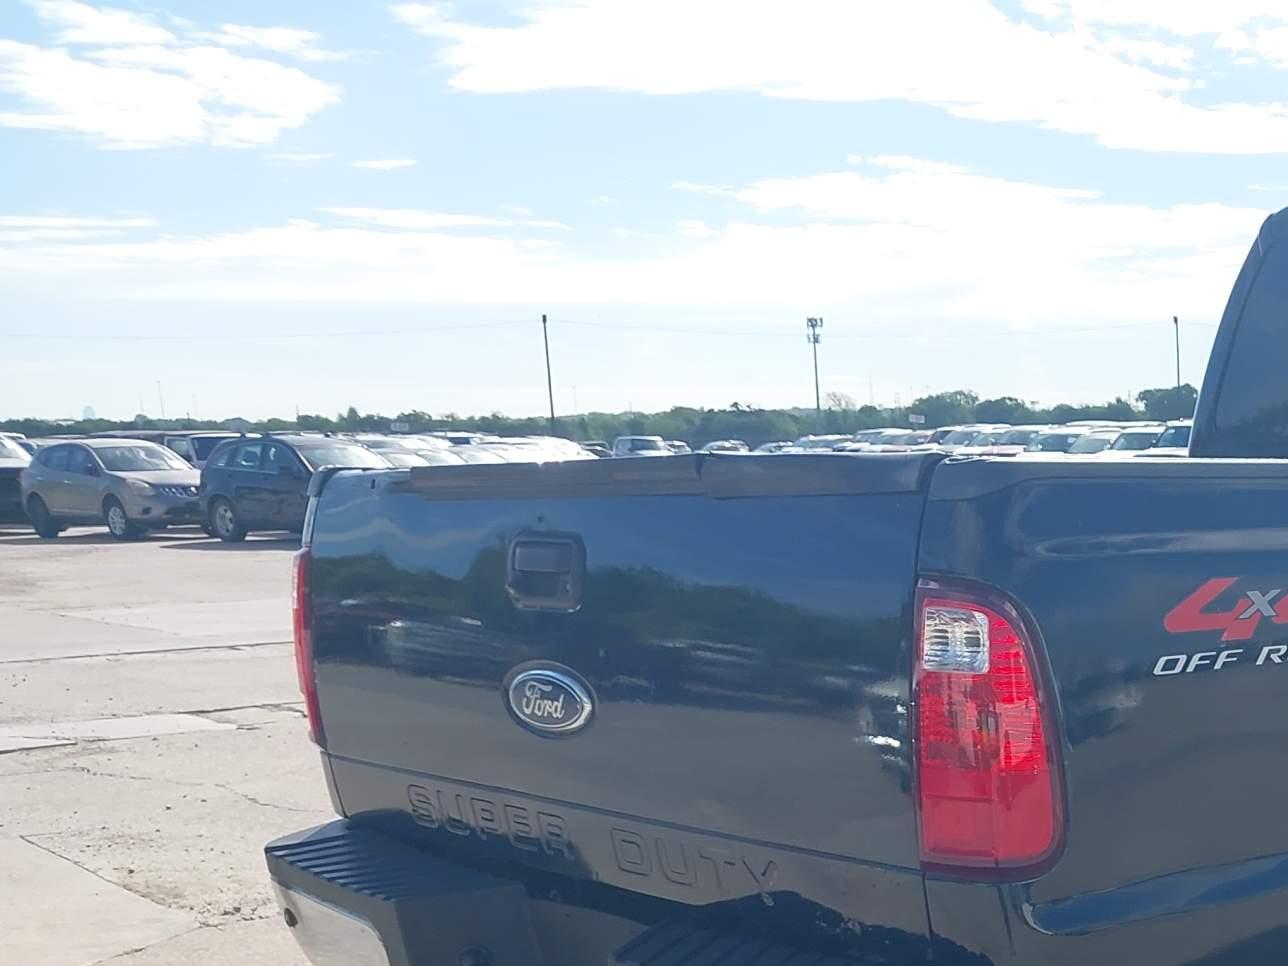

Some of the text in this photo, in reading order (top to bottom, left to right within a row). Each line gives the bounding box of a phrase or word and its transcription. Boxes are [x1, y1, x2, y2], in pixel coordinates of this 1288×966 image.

[1152, 648, 1244, 676] OFF
[522, 681, 566, 719] Ford
[406, 783, 780, 906] SUPER DUTY
